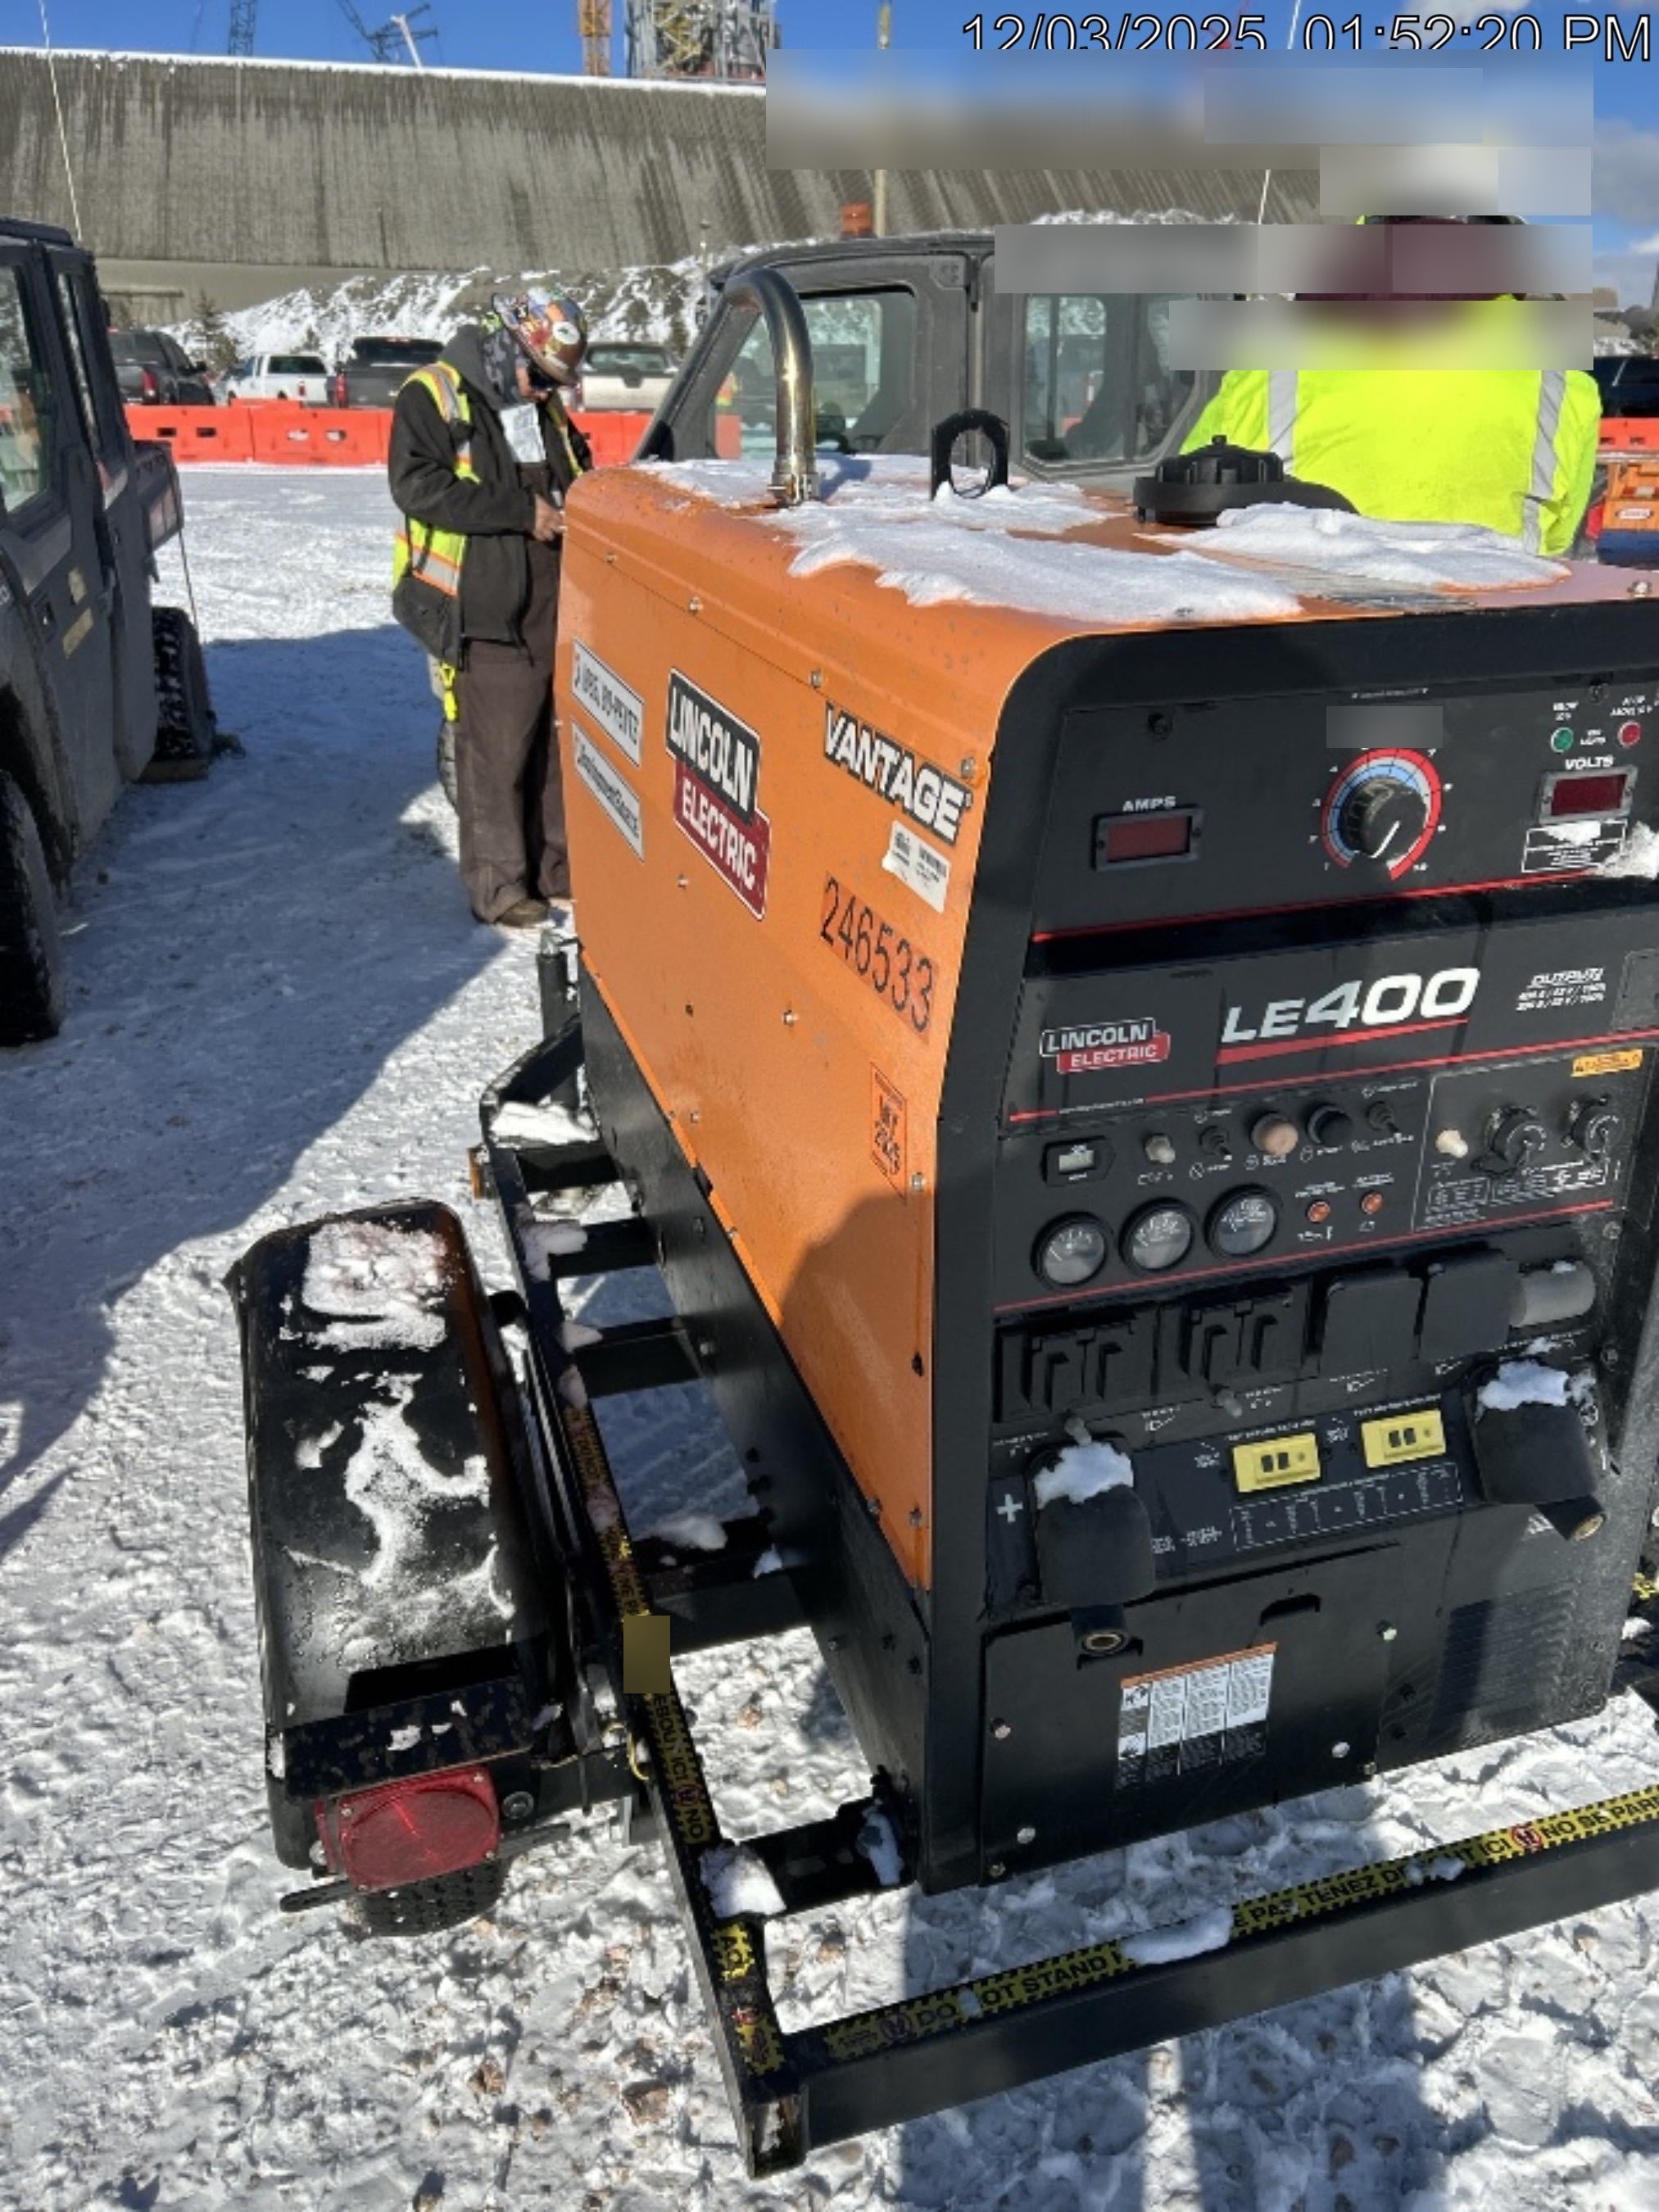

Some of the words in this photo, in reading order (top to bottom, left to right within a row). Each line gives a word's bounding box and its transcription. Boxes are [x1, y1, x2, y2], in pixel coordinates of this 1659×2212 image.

[670, 687, 754, 812] LINCOLN
[824, 705, 963, 843] VANTAGE
[1565, 755, 1614, 770] VOLTS
[682, 779, 757, 891] ELECTRIC
[1122, 795, 1176, 813] AMPS
[821, 877, 933, 1033] 246533
[1047, 1023, 1149, 1052] LINCOLN
[1221, 967, 1480, 1044] LE400
[1070, 1043, 1158, 1068] ELECTRIC
[687, 1808, 705, 1838] NO
[916, 2001, 958, 2028] DO
[1022, 1955, 1108, 1995] STAND
[1304, 1873, 1377, 1906] TENEZ
[1479, 1837, 1513, 1856] ICI
[1540, 1820, 1576, 1839] NO
[1578, 1811, 1611, 1829] SE
